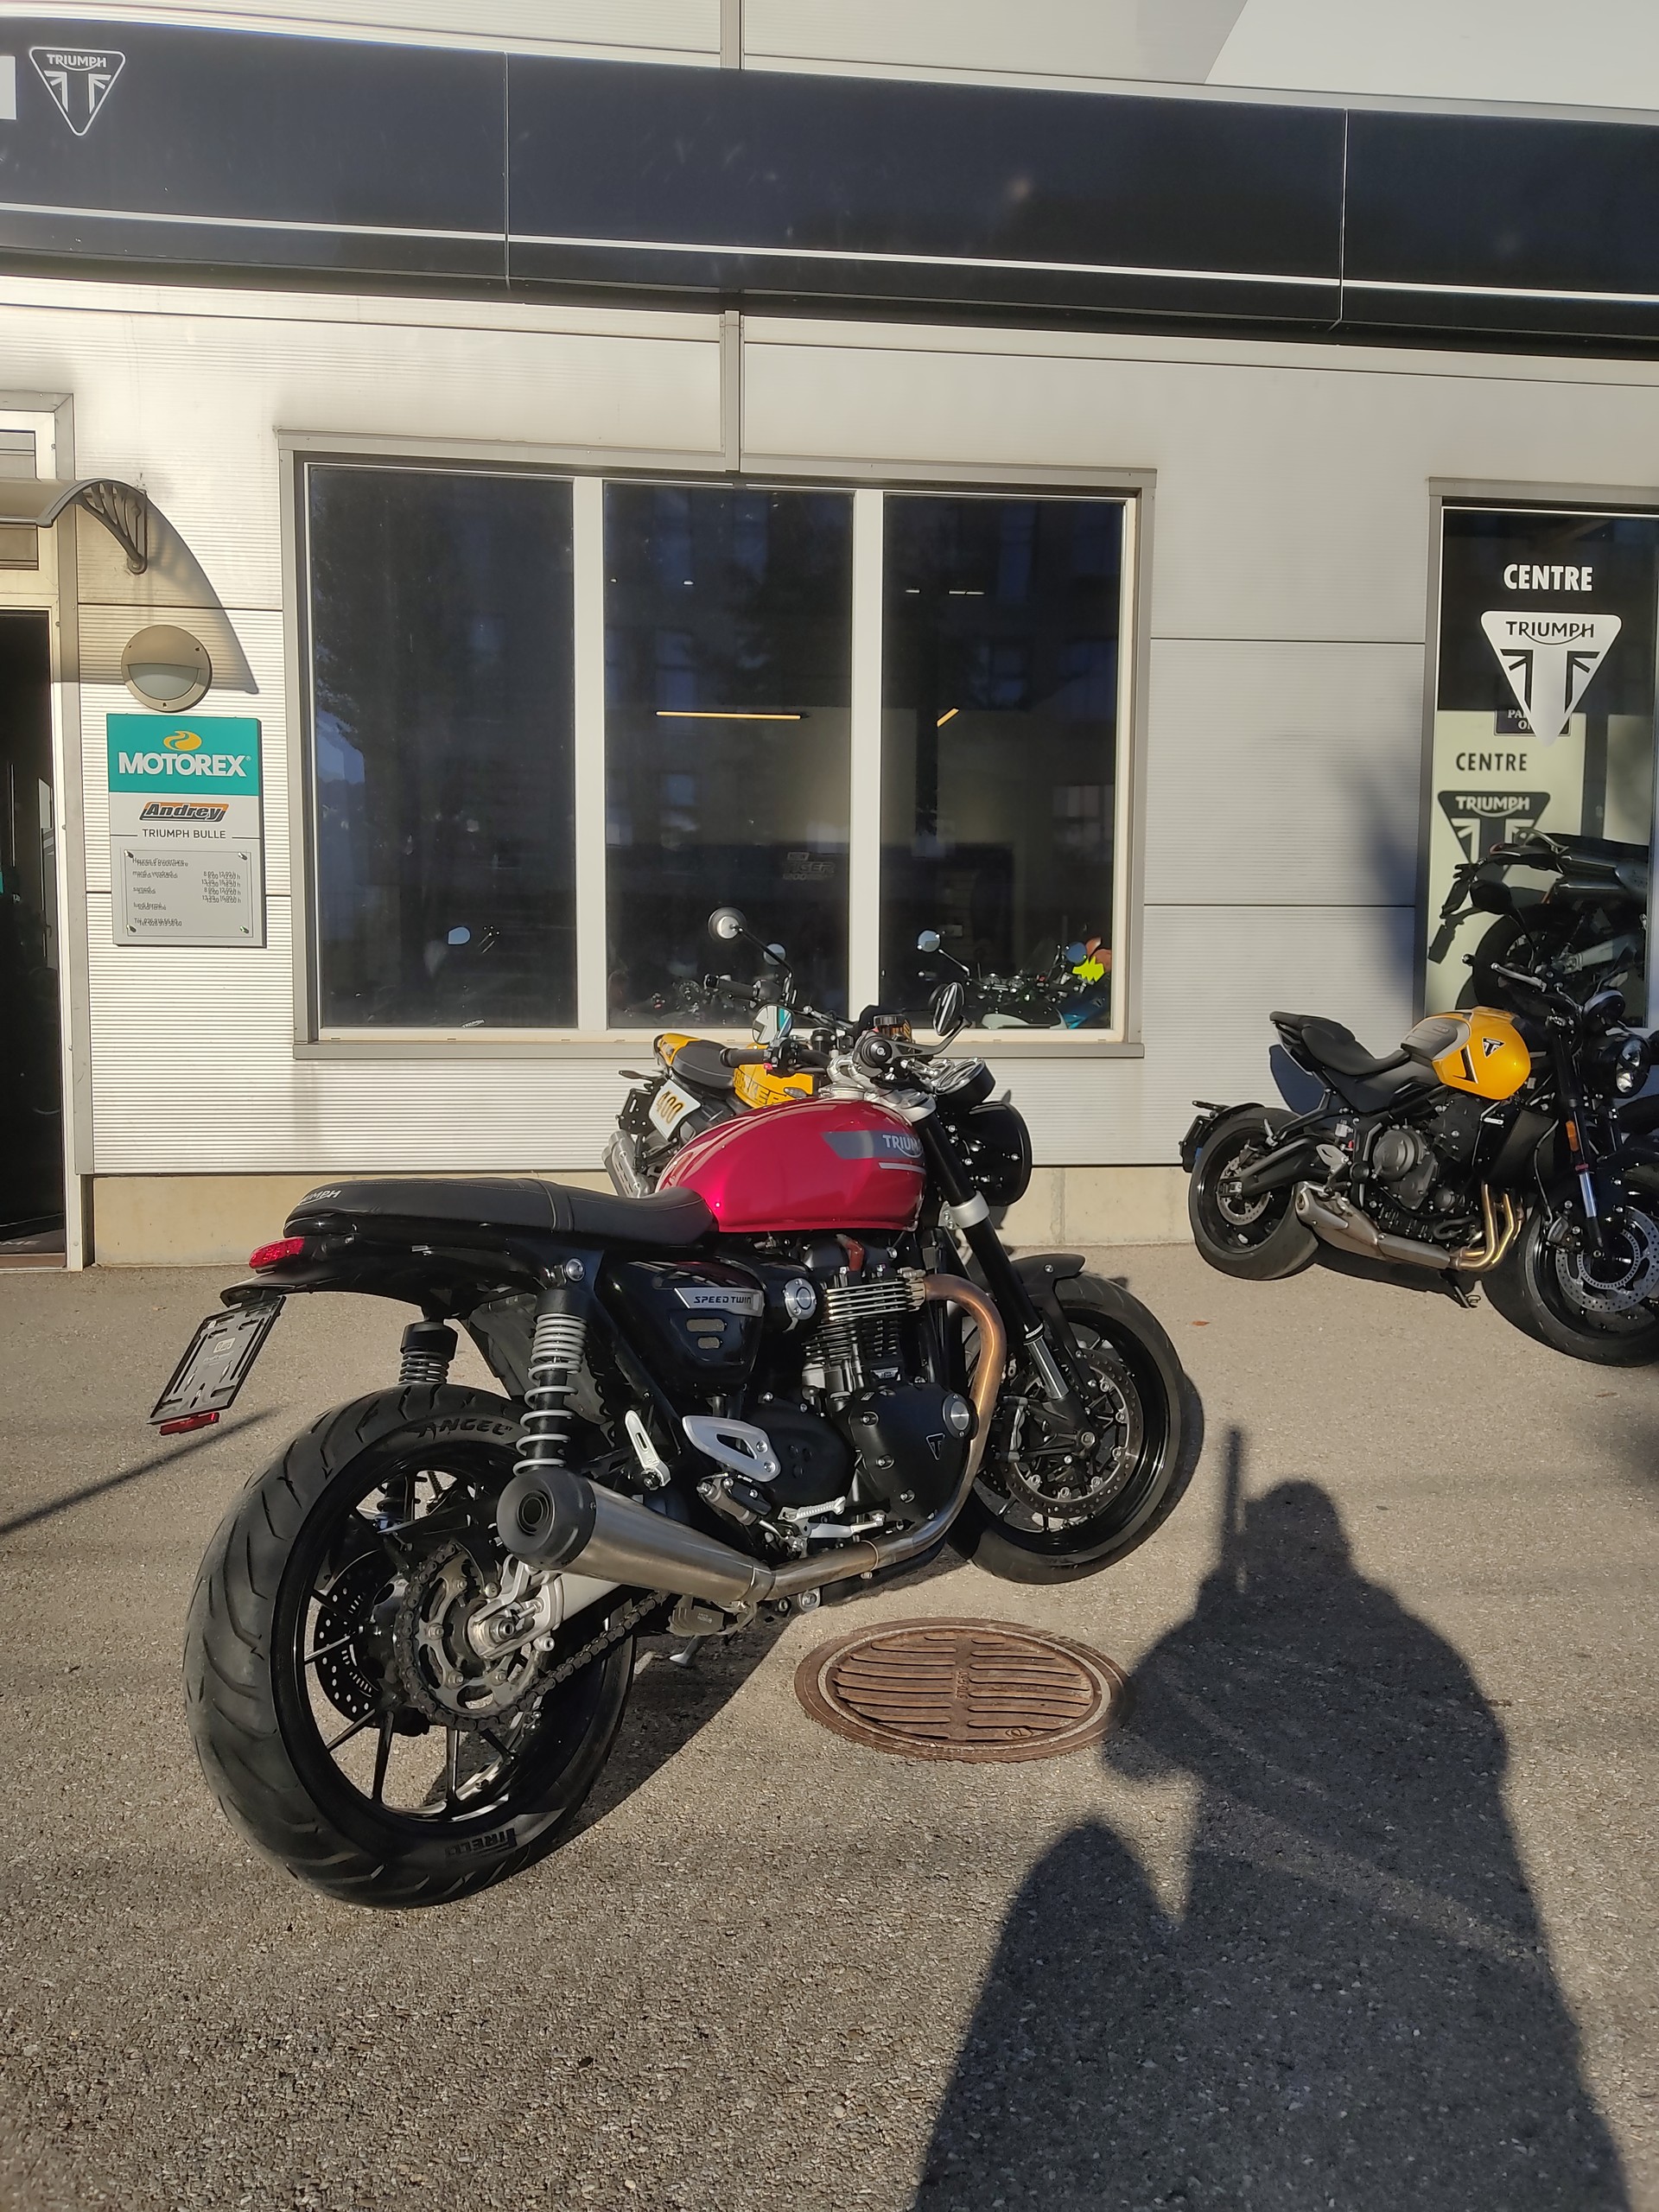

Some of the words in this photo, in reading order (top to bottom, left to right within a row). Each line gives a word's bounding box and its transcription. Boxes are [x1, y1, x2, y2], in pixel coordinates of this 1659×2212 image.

[47, 54, 106, 71] TRIUMPH
[1503, 563, 1592, 592] CENTRE
[1505, 620, 1595, 645] TRIUMPH
[118, 752, 247, 777] MOTOREX
[1456, 753, 1527, 772] CENTRE
[145, 804, 222, 820] Andrey
[1455, 796, 1530, 817] TRIUMPH
[142, 828, 190, 838] TRIUMPH
[193, 830, 226, 839] BULLE
[657, 1090, 683, 1124] 400
[882, 1134, 924, 1158] TRIUM
[417, 1418, 505, 1440] ANGEL
